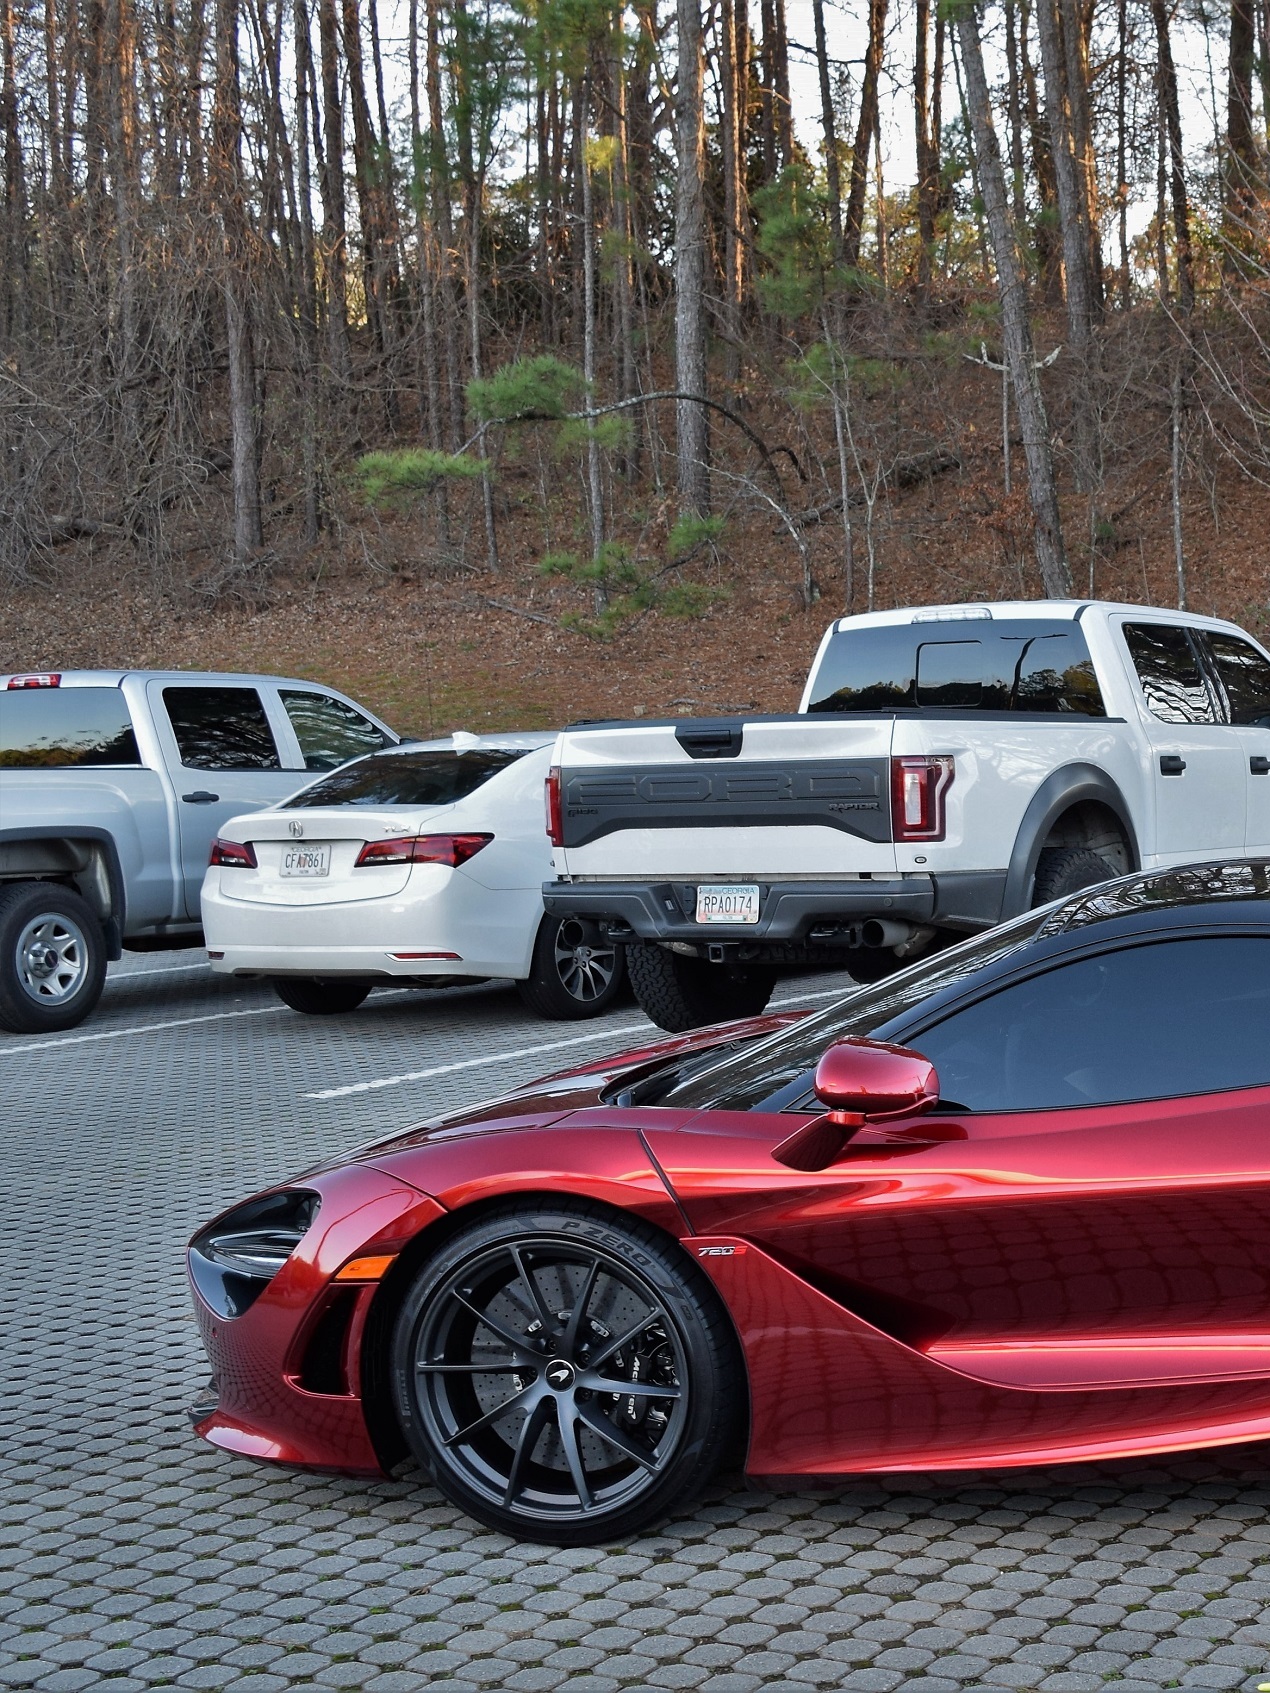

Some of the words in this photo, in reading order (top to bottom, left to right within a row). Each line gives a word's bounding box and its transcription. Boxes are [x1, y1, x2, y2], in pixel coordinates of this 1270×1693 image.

[567, 768, 880, 805] FORD
[829, 802, 882, 813] RAPTOR
[382, 824, 411, 832] TLX
[721, 887, 755, 895] GEORGIA
[703, 896, 752, 913] RPA0174
[561, 1221, 580, 1230] P
[583, 1227, 652, 1266] ZERO
[698, 1245, 748, 1257] 720S
